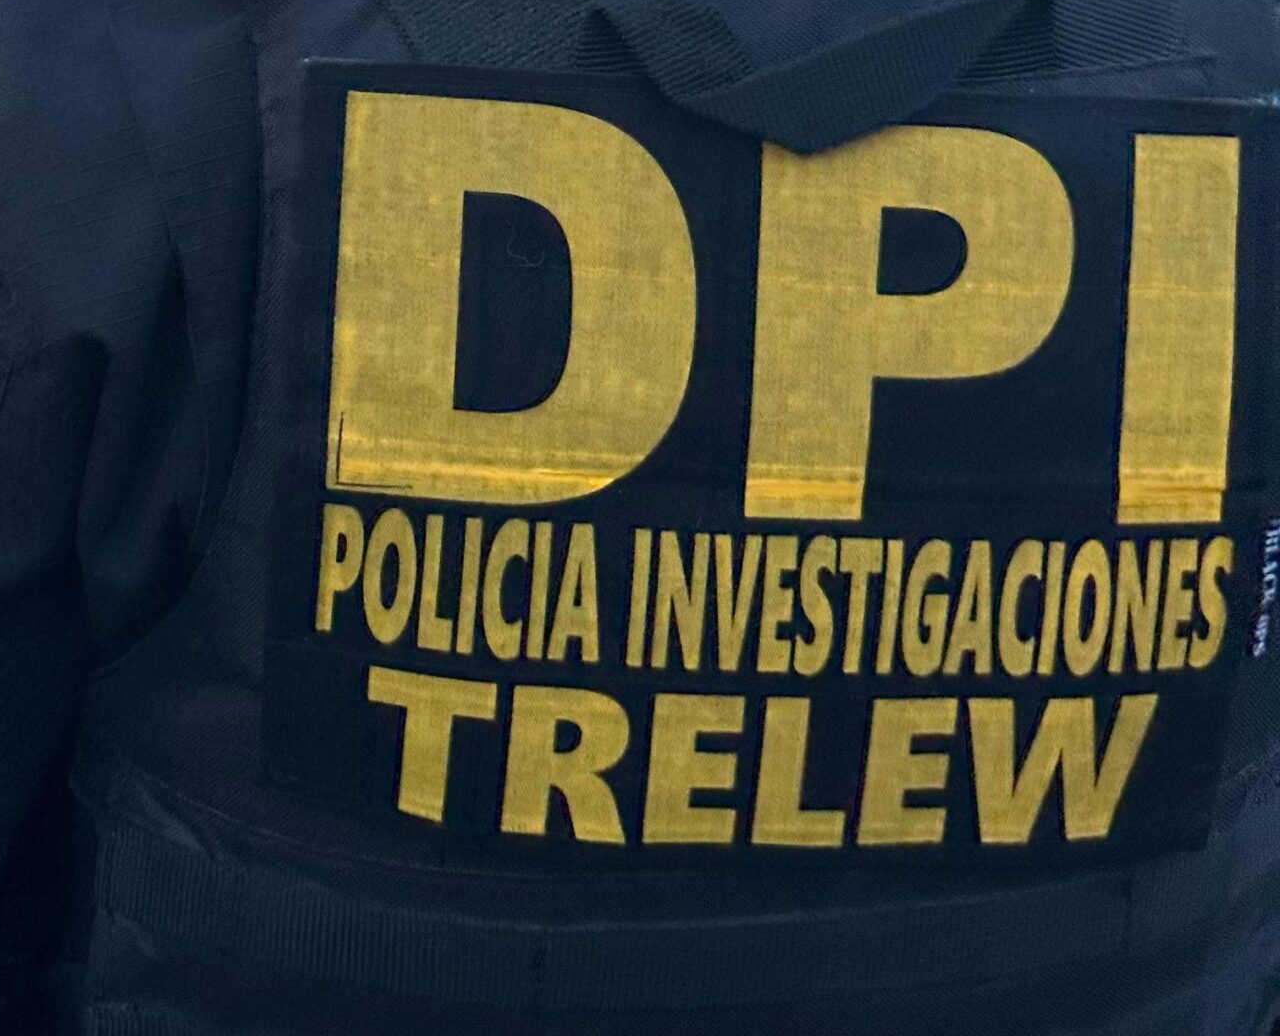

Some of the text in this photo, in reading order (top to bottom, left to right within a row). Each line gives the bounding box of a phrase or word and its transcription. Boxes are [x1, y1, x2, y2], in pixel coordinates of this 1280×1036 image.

[326, 91, 1240, 525] DPI
[316, 505, 1234, 678] POLICIA INVESTIGACIONES
[367, 667, 1158, 848] TRELEW
